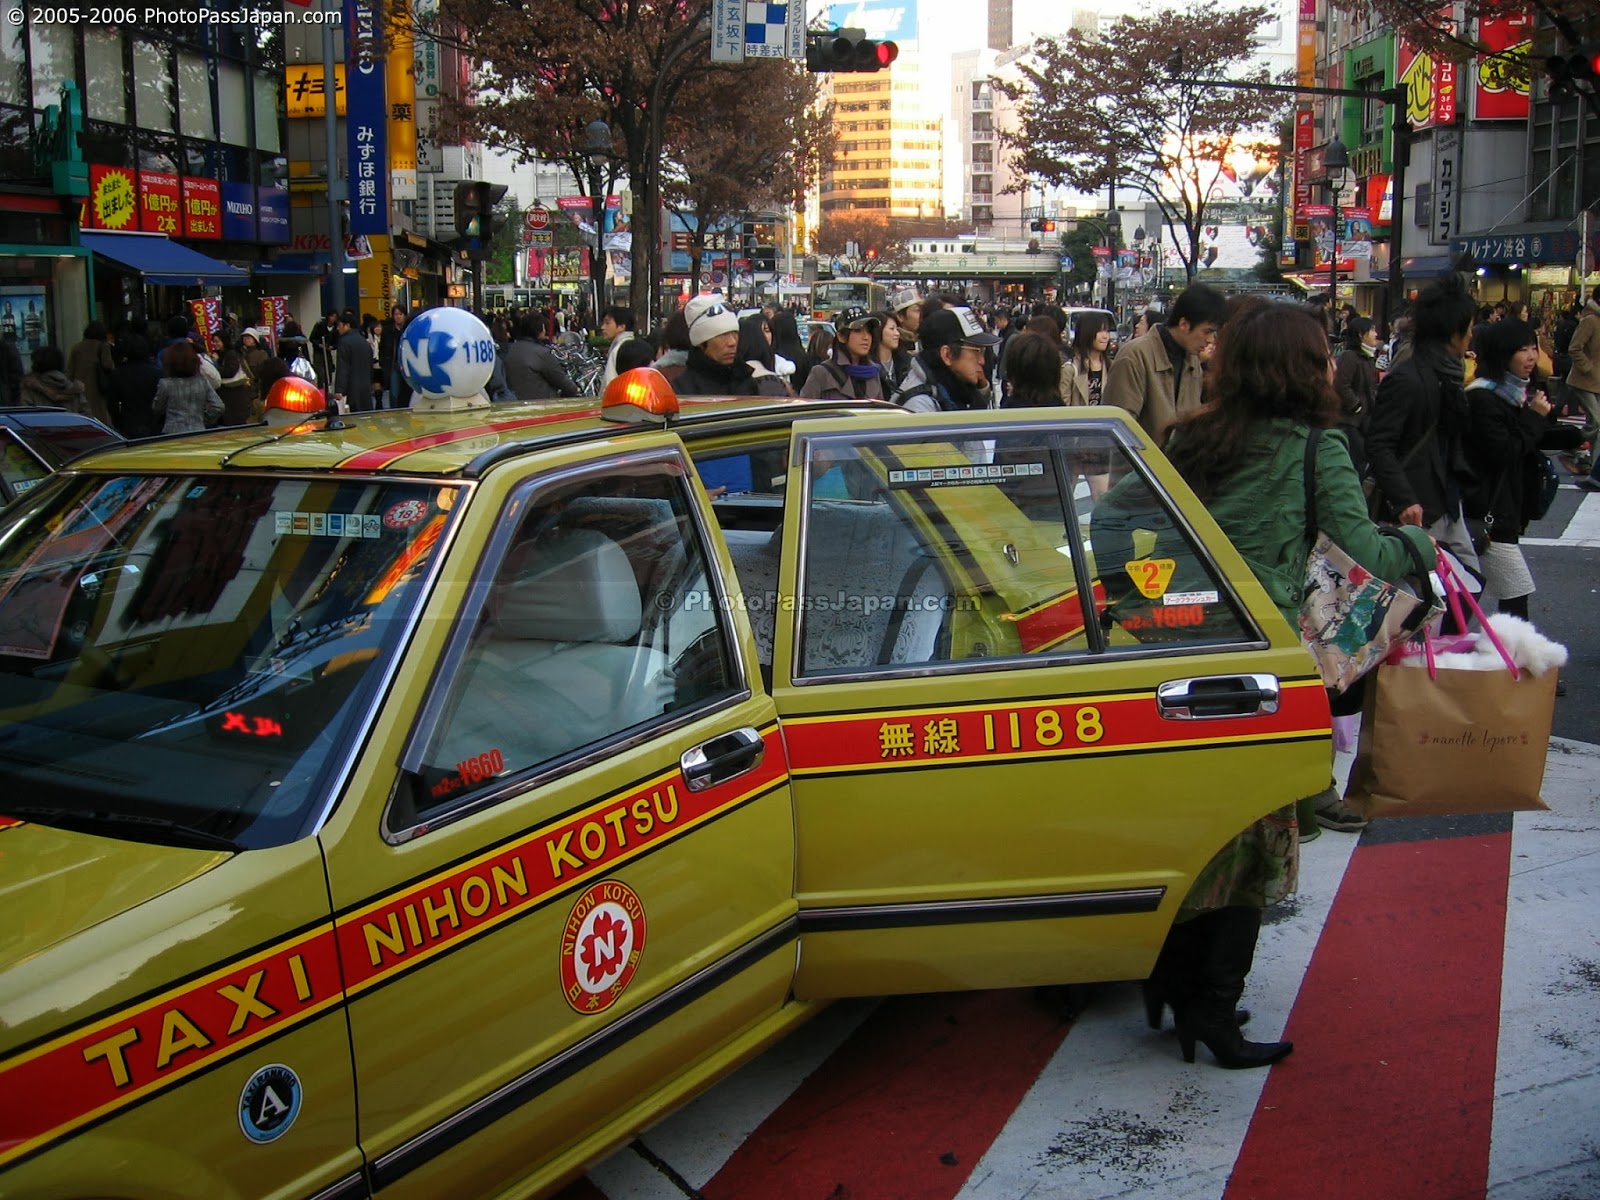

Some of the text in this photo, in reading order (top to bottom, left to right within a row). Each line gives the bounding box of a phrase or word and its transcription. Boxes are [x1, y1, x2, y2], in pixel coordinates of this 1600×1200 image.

[726, 0, 740, 56] 玄坂下
[746, 44, 783, 57] 時差式
[1441, 59, 1452, 82] コム
[286, 72, 344, 102] キヨ
[391, 103, 412, 121] 薬
[356, 126, 377, 215] みずほ銀行
[102, 190, 132, 219] 出ました
[142, 193, 178, 212] 1億円が
[185, 198, 217, 216] 1億円が
[226, 200, 253, 215] MIZUHO
[157, 215, 176, 233] 2本
[190, 220, 215, 233] 出ました
[676, 233, 740, 250] 三里薬品
[462, 341, 494, 363] 1188
[398, 508, 411, 519] 18
[1142, 562, 1161, 590] 2
[1152, 605, 1204, 628] ¥660
[879, 706, 1104, 758] 無線 1188
[457, 748, 504, 785] ¥660
[363, 785, 678, 966] NIHON KOTSU
[563, 884, 641, 956] NIHON KOTSU
[594, 929, 615, 967] N
[83, 954, 312, 1088] TAXI
[243, 1082, 257, 1110] TAXI
[255, 1085, 290, 1126] A
